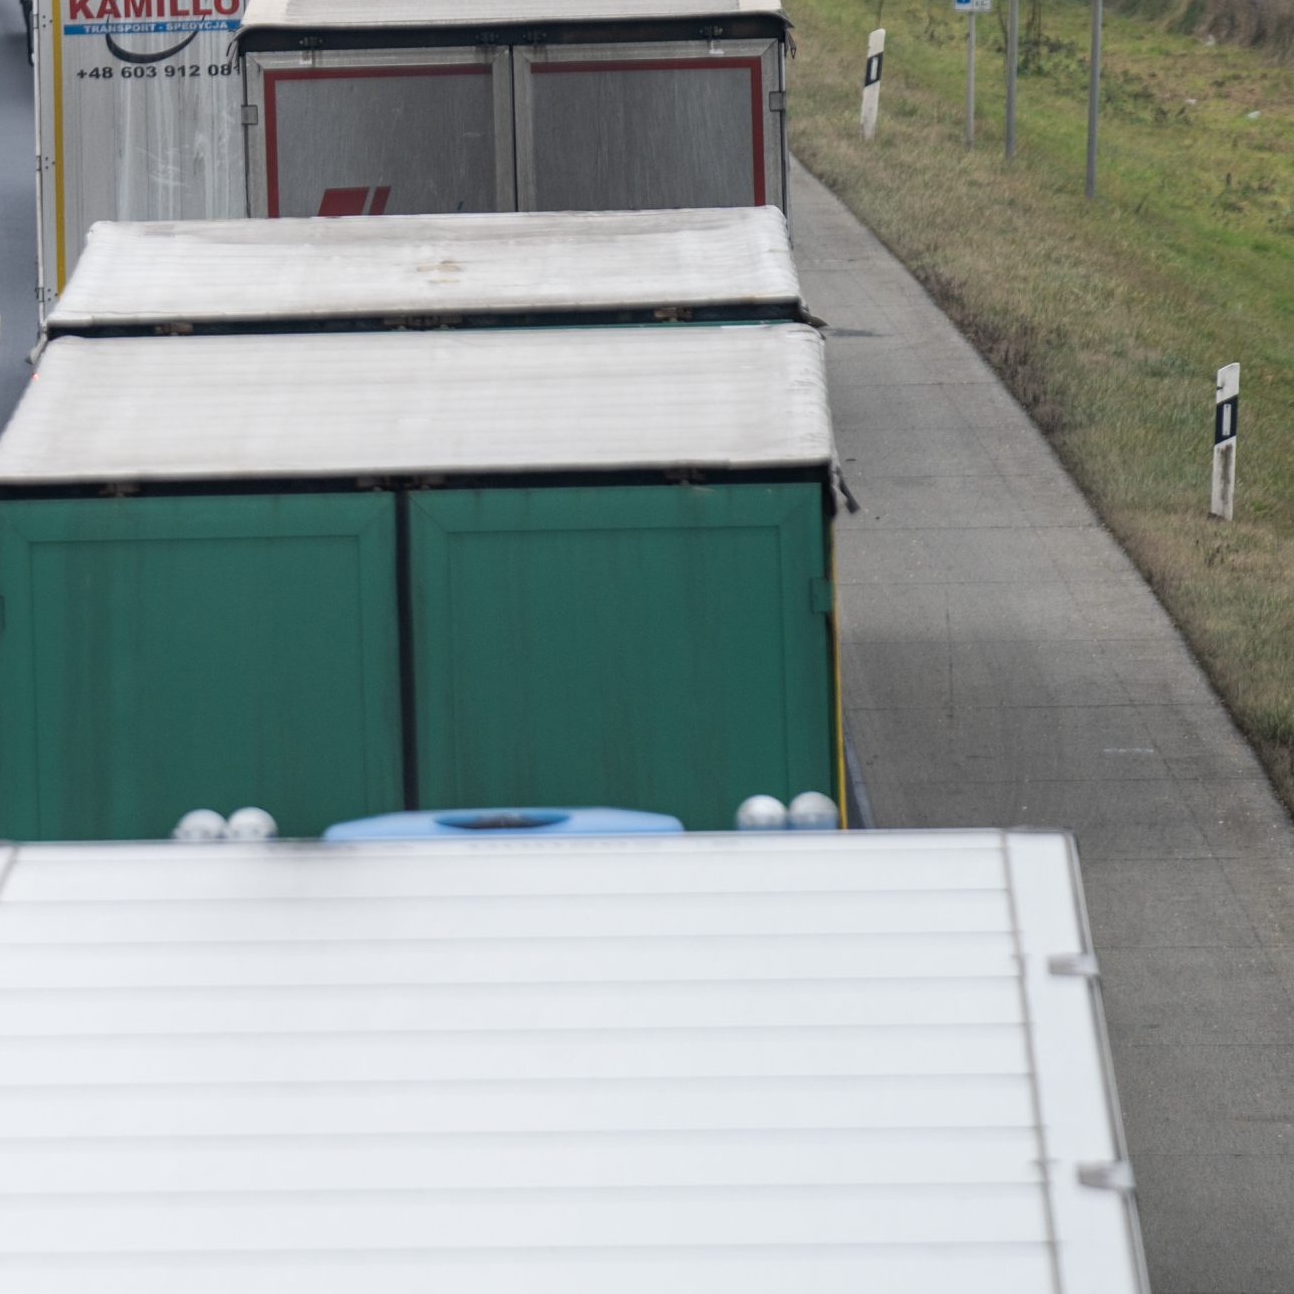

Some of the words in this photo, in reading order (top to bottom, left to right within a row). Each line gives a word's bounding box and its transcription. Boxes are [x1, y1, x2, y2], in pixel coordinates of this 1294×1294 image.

[83, 23, 156, 34] TRANSPORT
[166, 21, 228, 31] SPEDYCJA
[77, 66, 113, 80] +48
[121, 66, 157, 79] 603
[164, 65, 200, 78] 912
